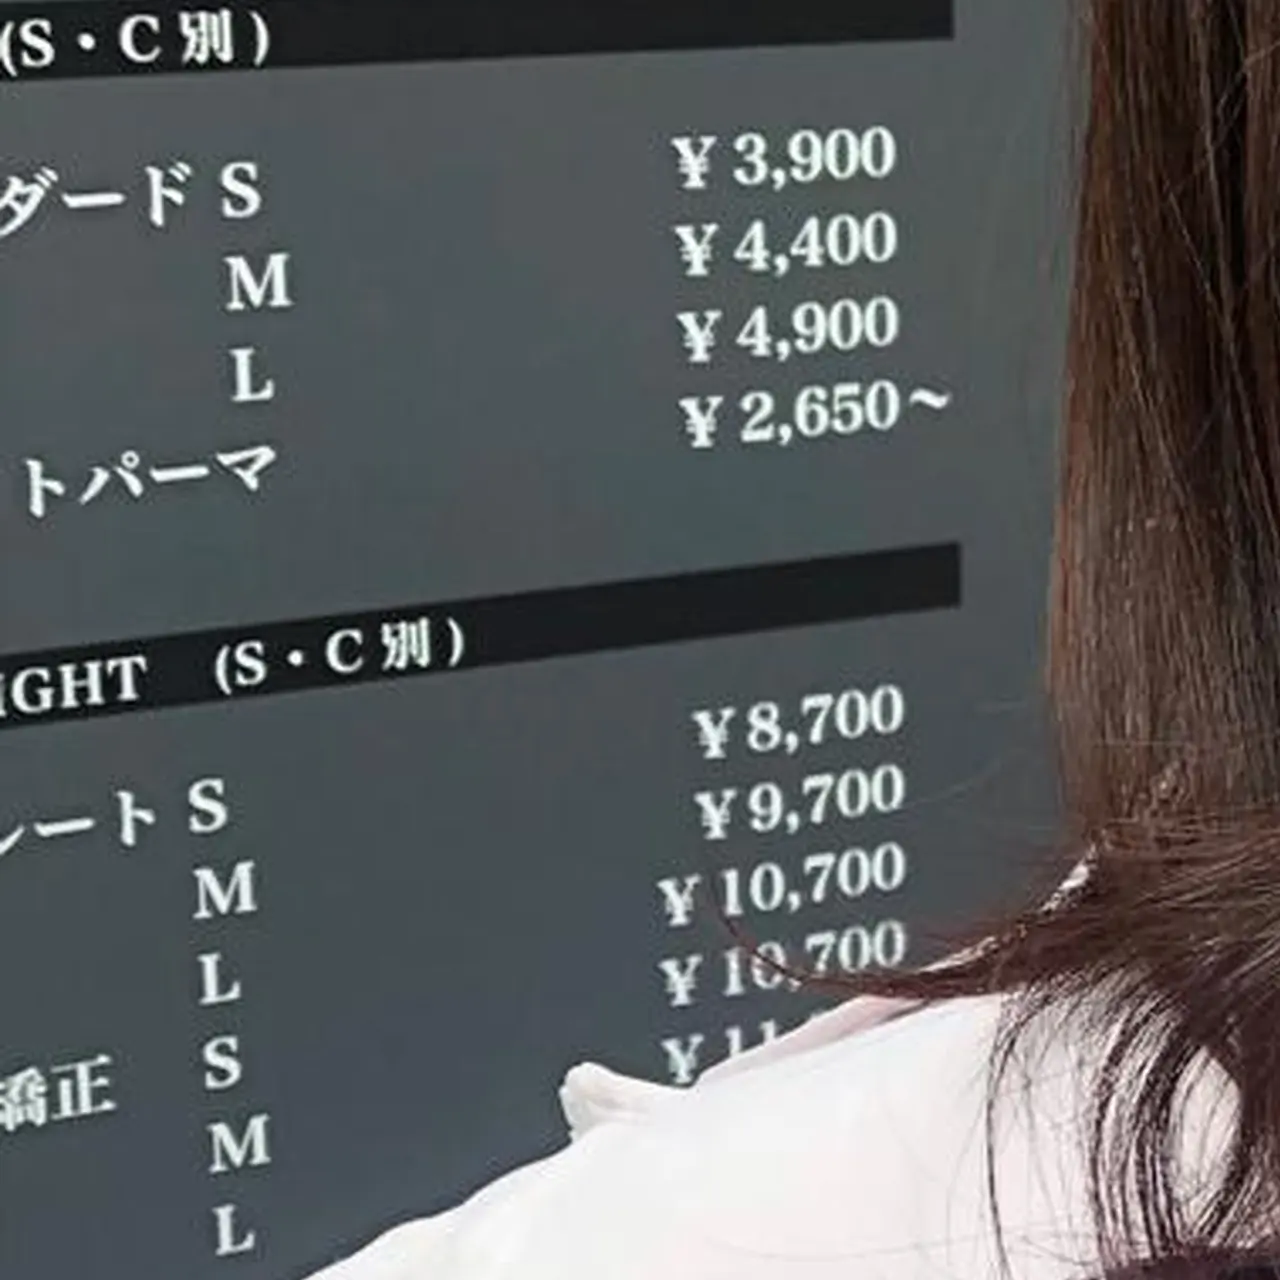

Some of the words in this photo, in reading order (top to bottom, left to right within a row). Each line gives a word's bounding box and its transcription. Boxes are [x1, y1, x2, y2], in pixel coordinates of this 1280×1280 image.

[672, 126, 896, 190] ¥3,900
[221, 162, 261, 218] S
[675, 212, 897, 276] ¥4,400
[225, 253, 291, 310] M
[677, 296, 898, 362] ¥4,900
[231, 348, 274, 401] L
[26, 446, 275, 517] トパーマ
[693, 685, 903, 758] ¥8,700
[189, 779, 227, 832] S
[695, 765, 904, 839] ¥9,700
[194, 861, 256, 918] M
[658, 843, 905, 926] ¥10,700
[199, 954, 240, 1004] L
[204, 1037, 241, 1088] S
[209, 1115, 270, 1172] M
[215, 1205, 254, 1255] L
